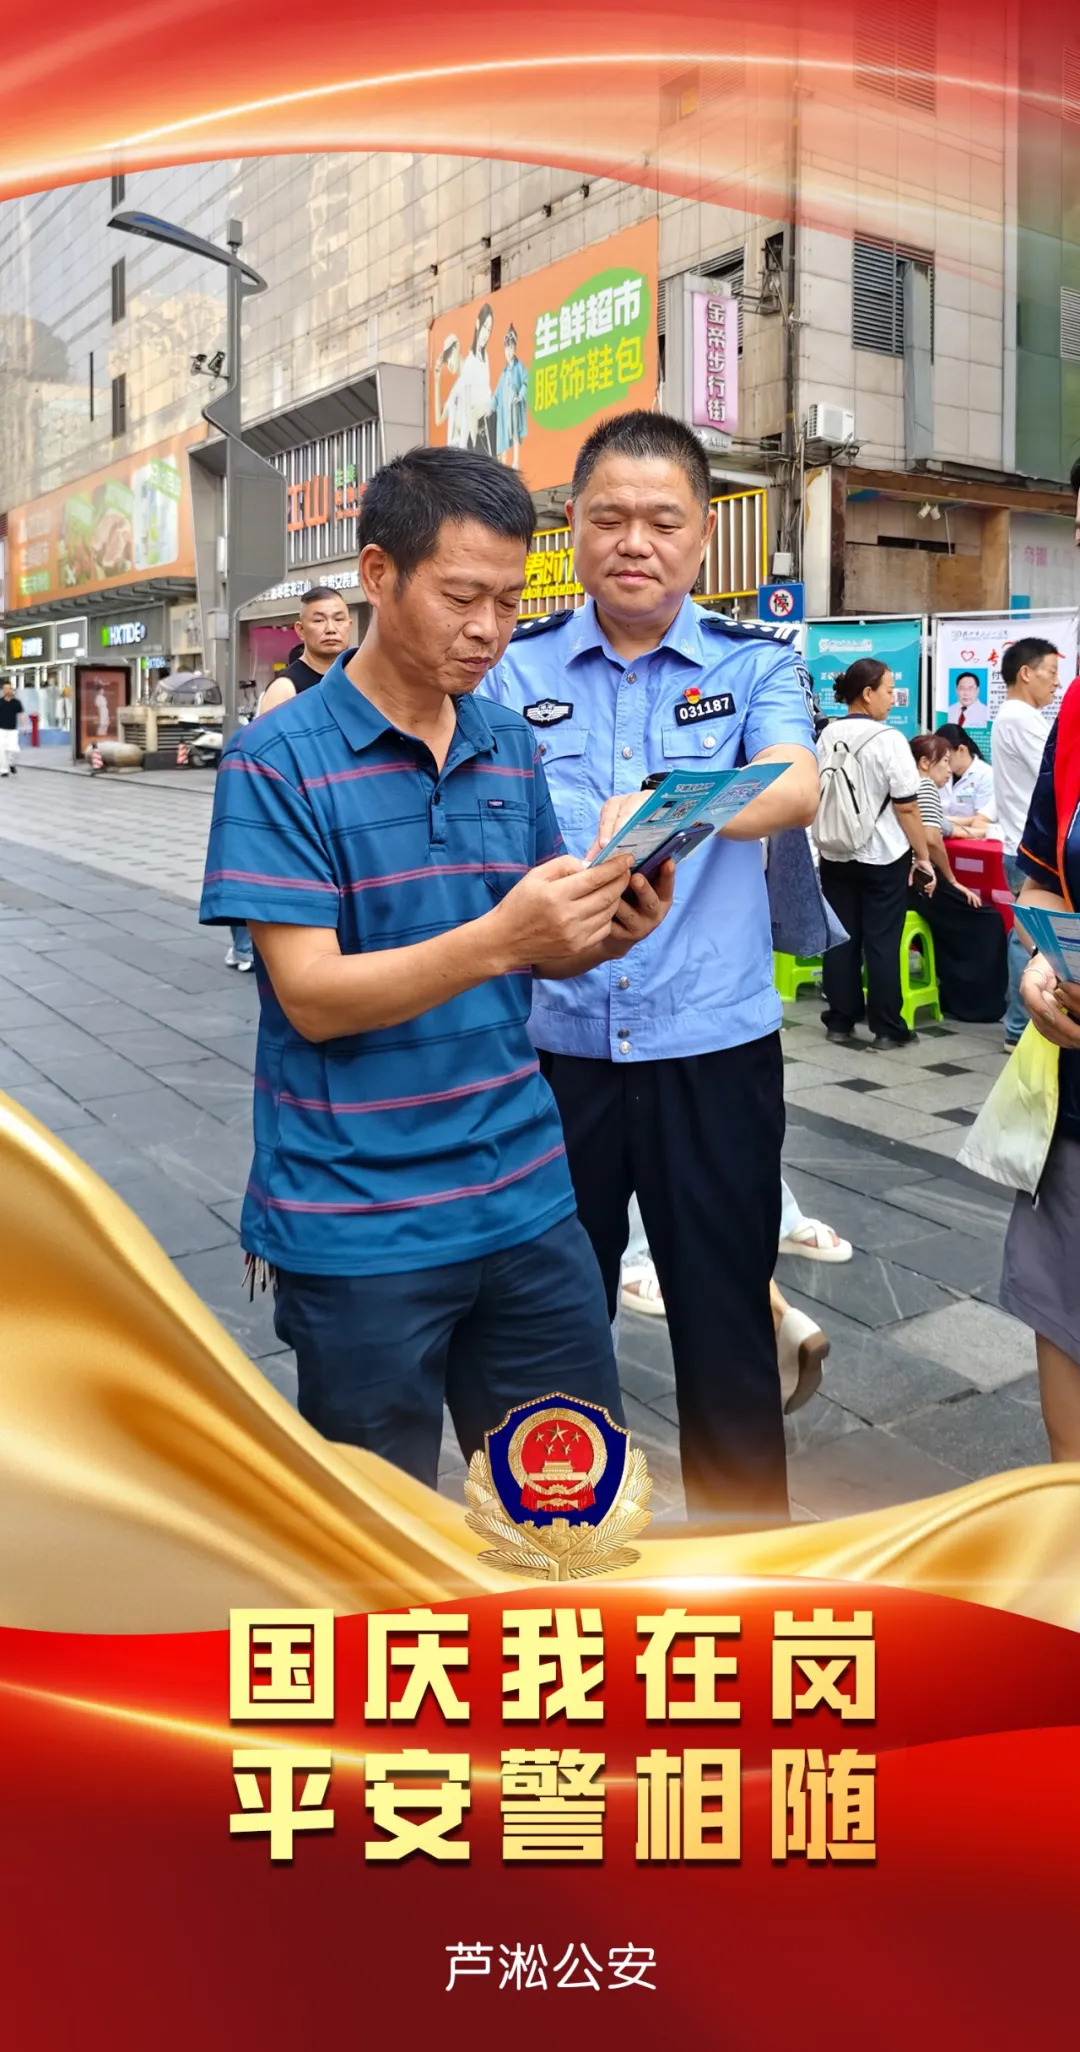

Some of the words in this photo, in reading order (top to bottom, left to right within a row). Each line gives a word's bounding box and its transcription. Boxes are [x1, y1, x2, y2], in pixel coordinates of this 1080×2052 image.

[534, 277, 642, 360] 生鲜超市
[534, 336, 643, 412] 服饰鞋包
[707, 301, 726, 423] 金帝步行街
[679, 697, 730, 720] 031187
